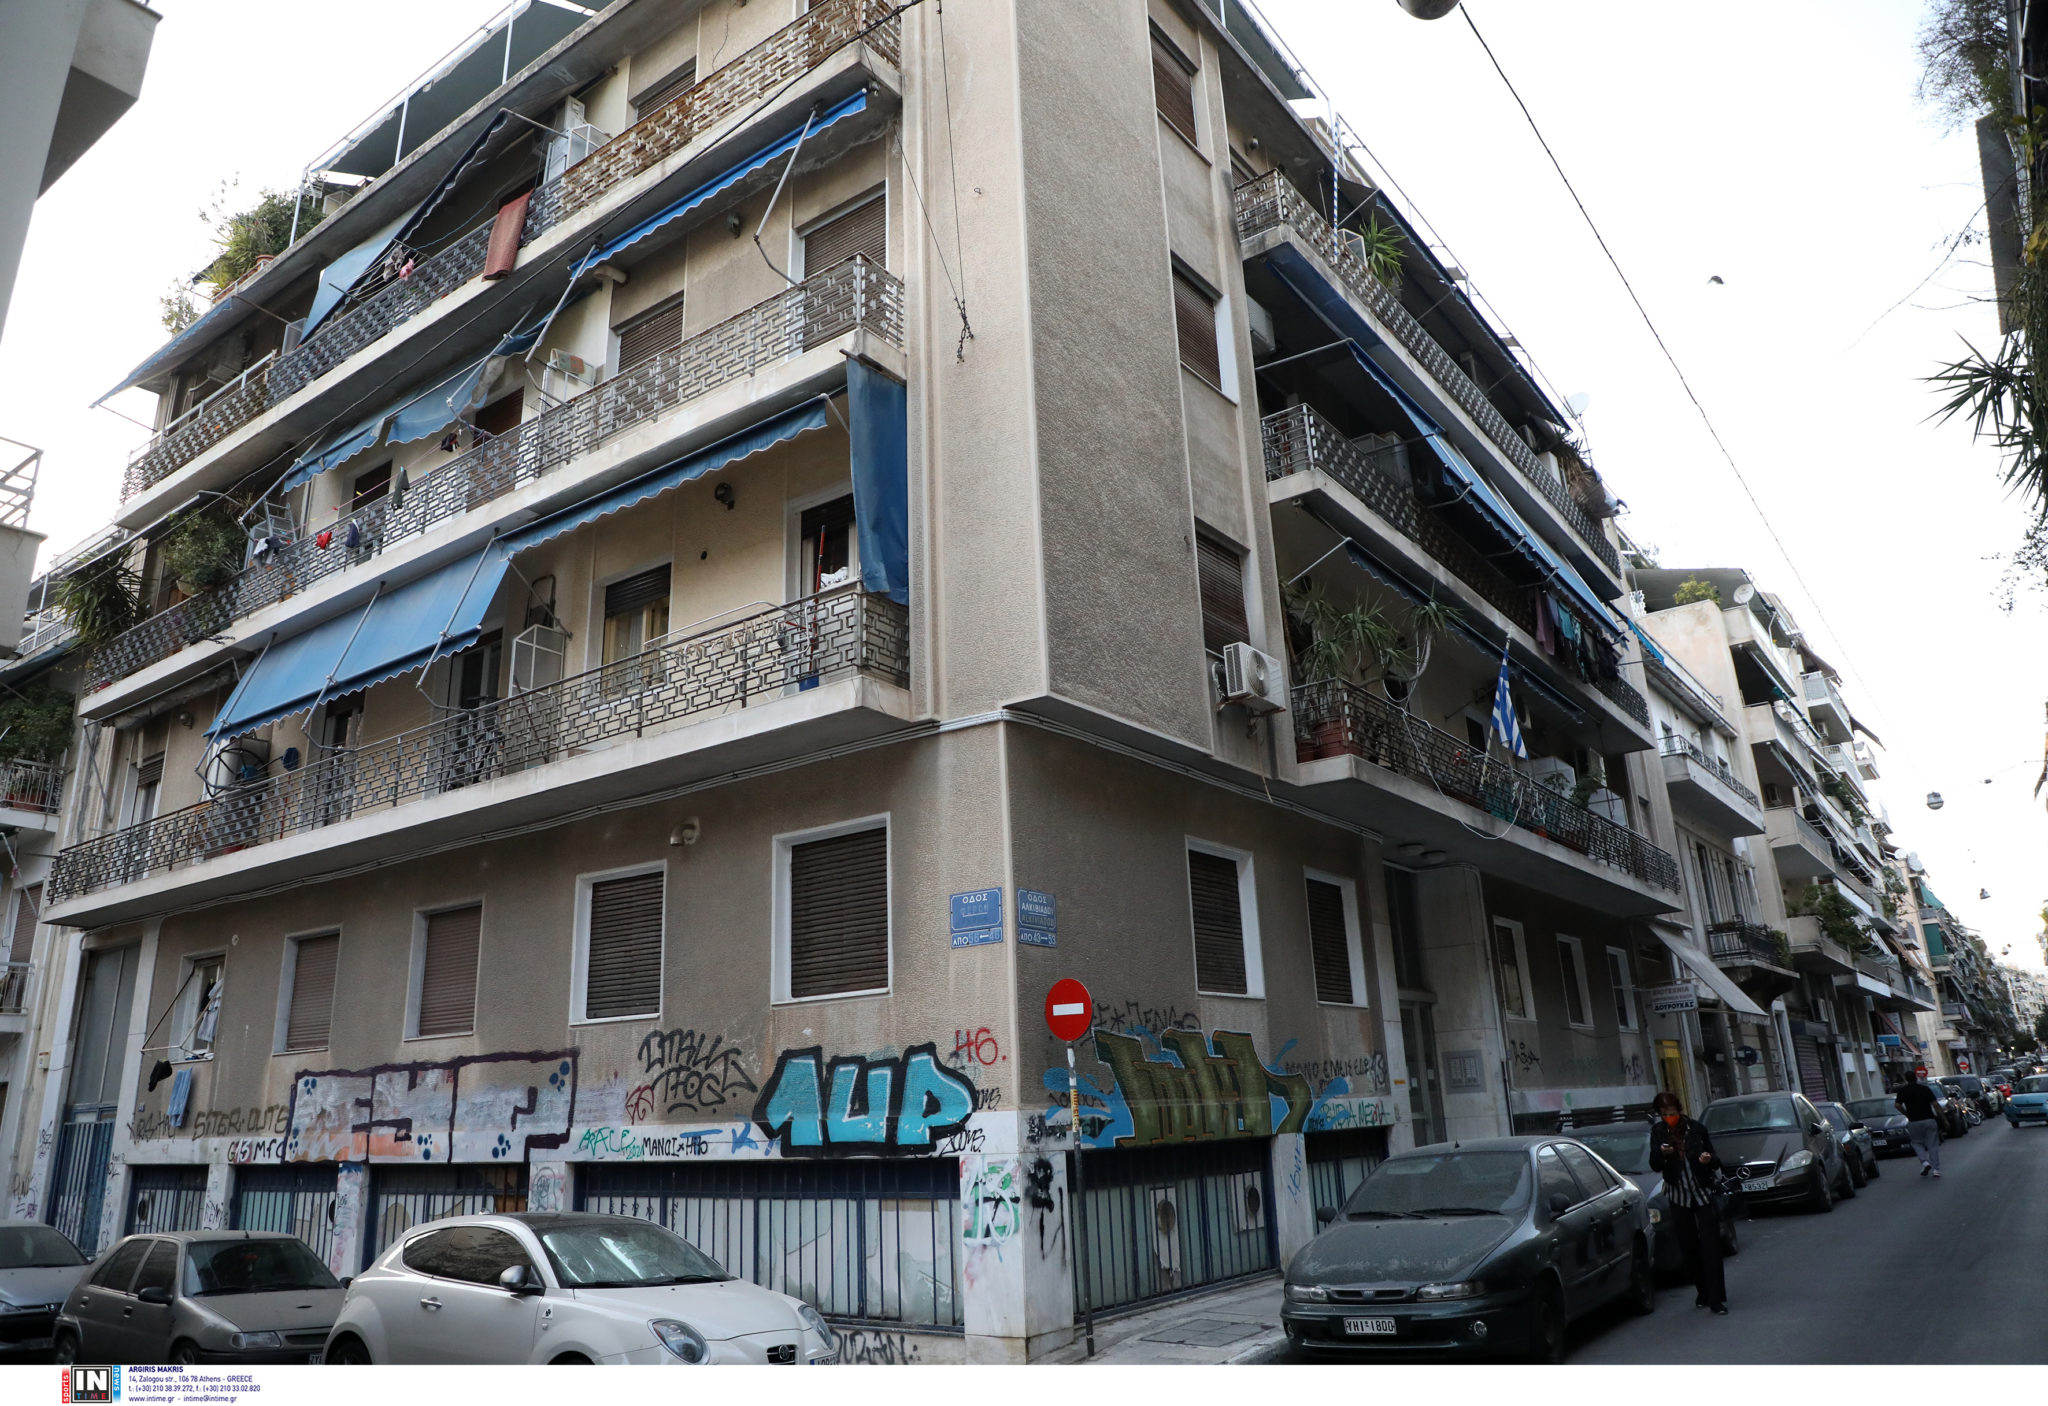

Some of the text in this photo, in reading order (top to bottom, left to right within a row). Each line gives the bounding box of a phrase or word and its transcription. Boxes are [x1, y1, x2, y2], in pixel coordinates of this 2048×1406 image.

[962, 893, 988, 904] ΟΔΟΣ
[1027, 894, 1048, 904] ΟΔΟΣ
[1021, 902, 1054, 915] ΑΛΚΙΒΙΑΔΟΥ
[953, 936, 969, 947] ΑΠΟ
[1020, 933, 1033, 942] ΑΠΟ
